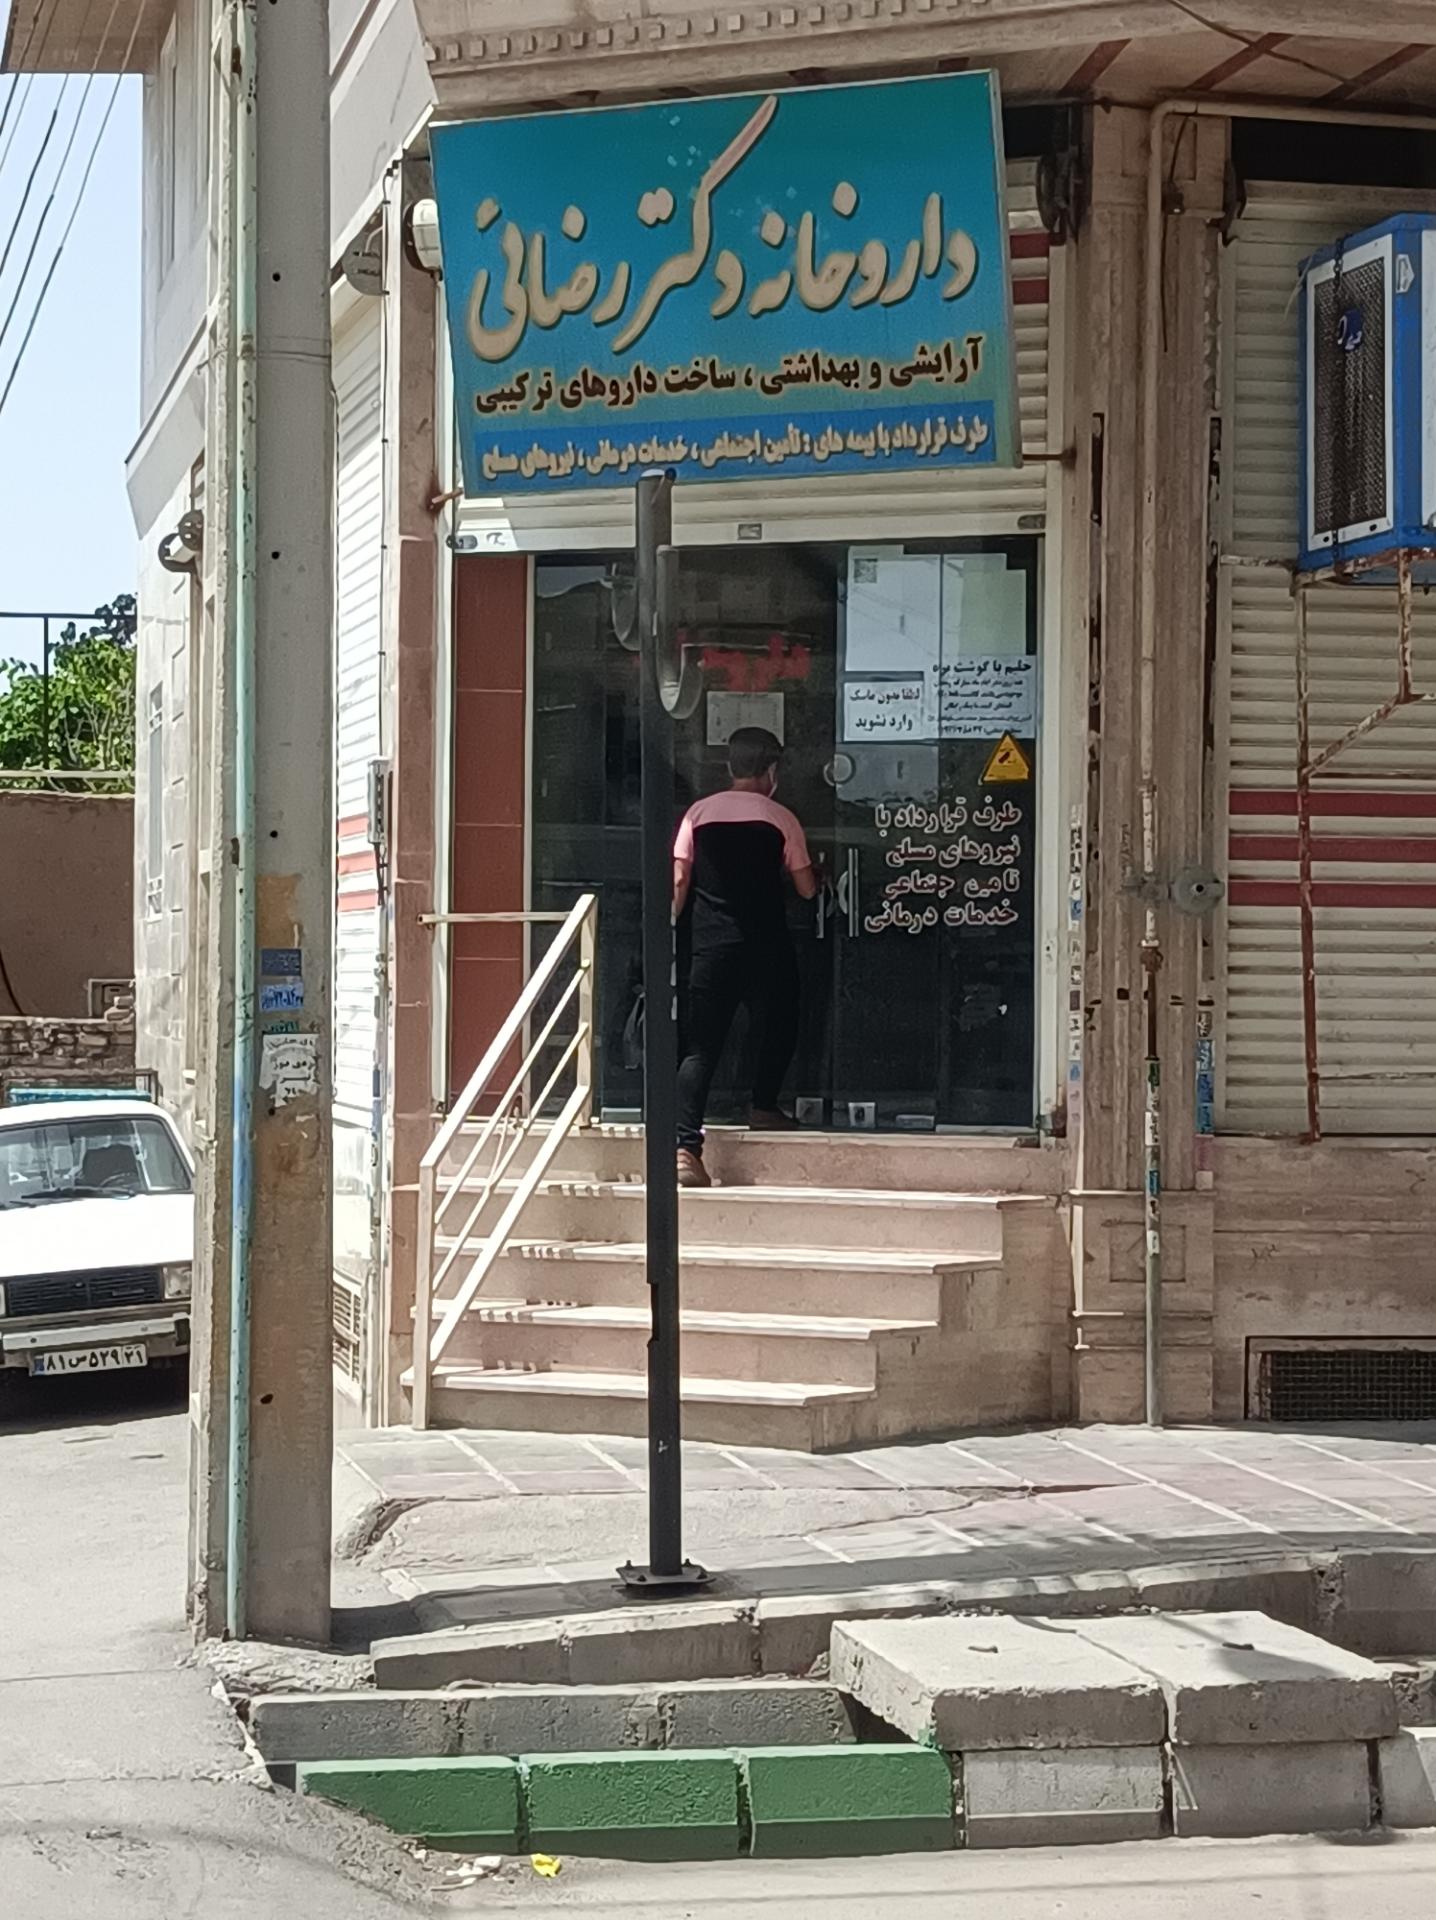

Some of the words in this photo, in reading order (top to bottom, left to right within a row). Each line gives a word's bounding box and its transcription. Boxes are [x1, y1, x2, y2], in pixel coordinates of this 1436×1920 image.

[612, 95, 778, 353] دکتر
[749, 181, 978, 318] داروخانه
[663, 357, 737, 396] ساخت
[760, 350, 861, 396] بهداشتی
[867, 360, 882, 389] و
[889, 335, 984, 388] آرایشی
[475, 371, 554, 414] ترکیبی
[559, 364, 658, 407] داروهای
[638, 434, 688, 463] خدمات
[846, 429, 875, 457] بیمه
[892, 415, 948, 456] قرارداد
[950, 414, 988, 453] طرف
[481, 443, 519, 480] مسلح
[849, 688, 877, 702] ماسک
[855, 714, 887, 732] نشوید
[889, 712, 913, 732] وارد
[875, 802, 892, 837] با
[894, 796, 968, 833] قرارداد
[972, 795, 1022, 832] طرف
[886, 836, 936, 867] مسلح
[938, 834, 1022, 867] نیروهای
[864, 900, 939, 934] درمانی
[943, 898, 1019, 926] خدمات
